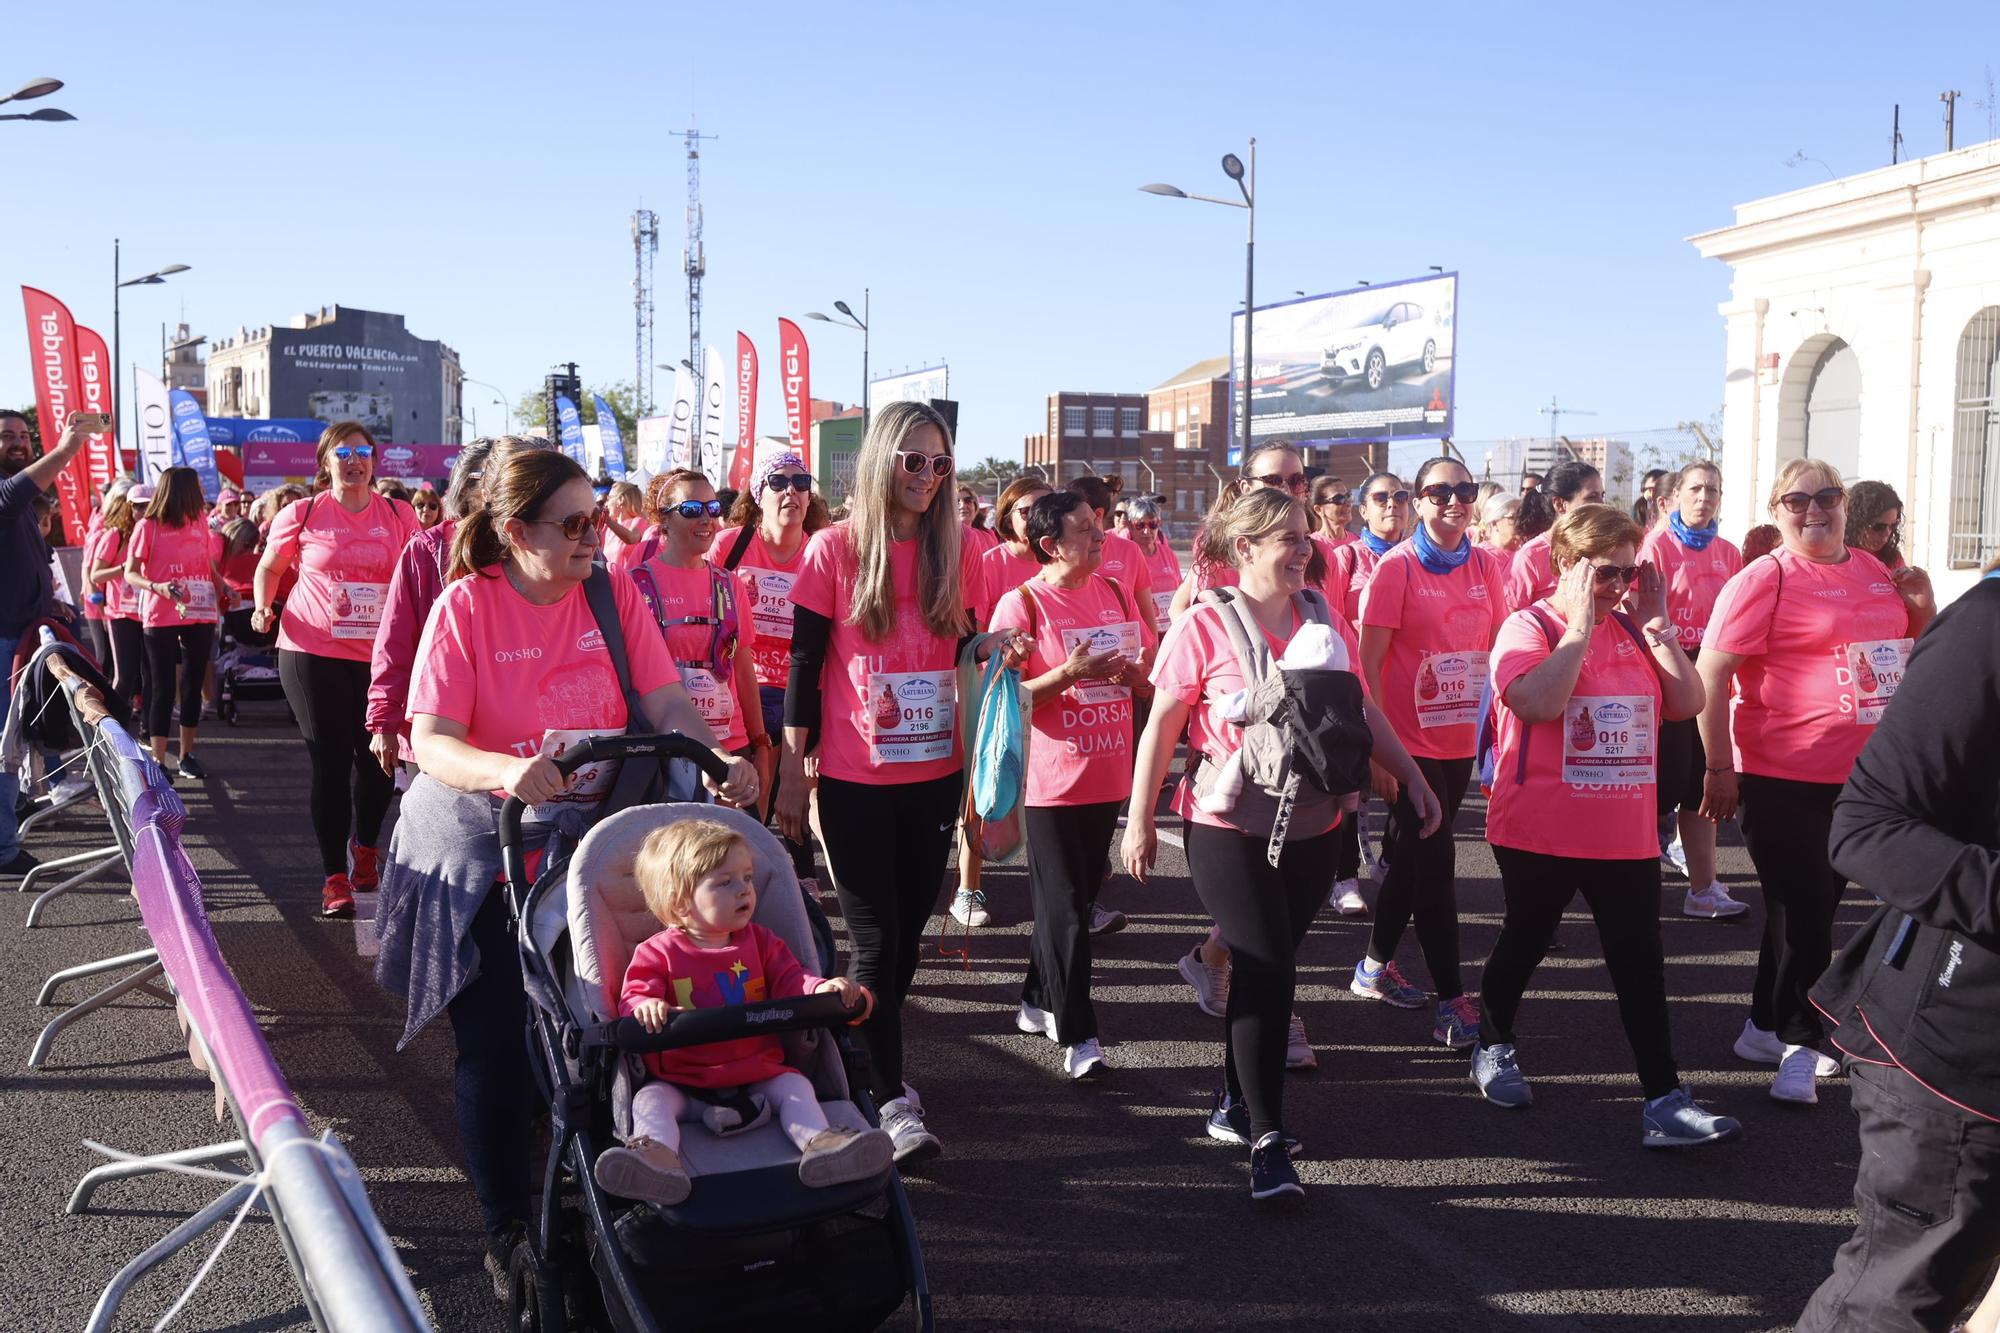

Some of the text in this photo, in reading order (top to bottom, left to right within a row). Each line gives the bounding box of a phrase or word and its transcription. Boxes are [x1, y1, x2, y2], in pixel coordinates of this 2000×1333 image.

[299, 344, 343, 358] PUERTO
[169, 565, 184, 574] TU
[663, 597, 684, 605] SHO
[760, 595, 787, 607] 016
[353, 604, 375, 614] 016
[763, 606, 781, 615] 4662
[1676, 608, 1694, 621] TU
[495, 647, 542, 663] OYSHO
[856, 656, 883, 676] TU
[1441, 680, 1465, 692] 016
[902, 688, 935, 696] ASTURIANA
[1445, 693, 1461, 701] 5214
[903, 707, 934, 720] 016
[1598, 710, 1630, 719] ASTURIANA
[910, 723, 929, 731] 2196
[1599, 731, 1629, 743] 016
[1066, 730, 1126, 754] SUMA
[880, 748, 910, 756] OYSHO
[1605, 746, 1624, 755] 5217
[1572, 770, 1604, 778] OYSHO
